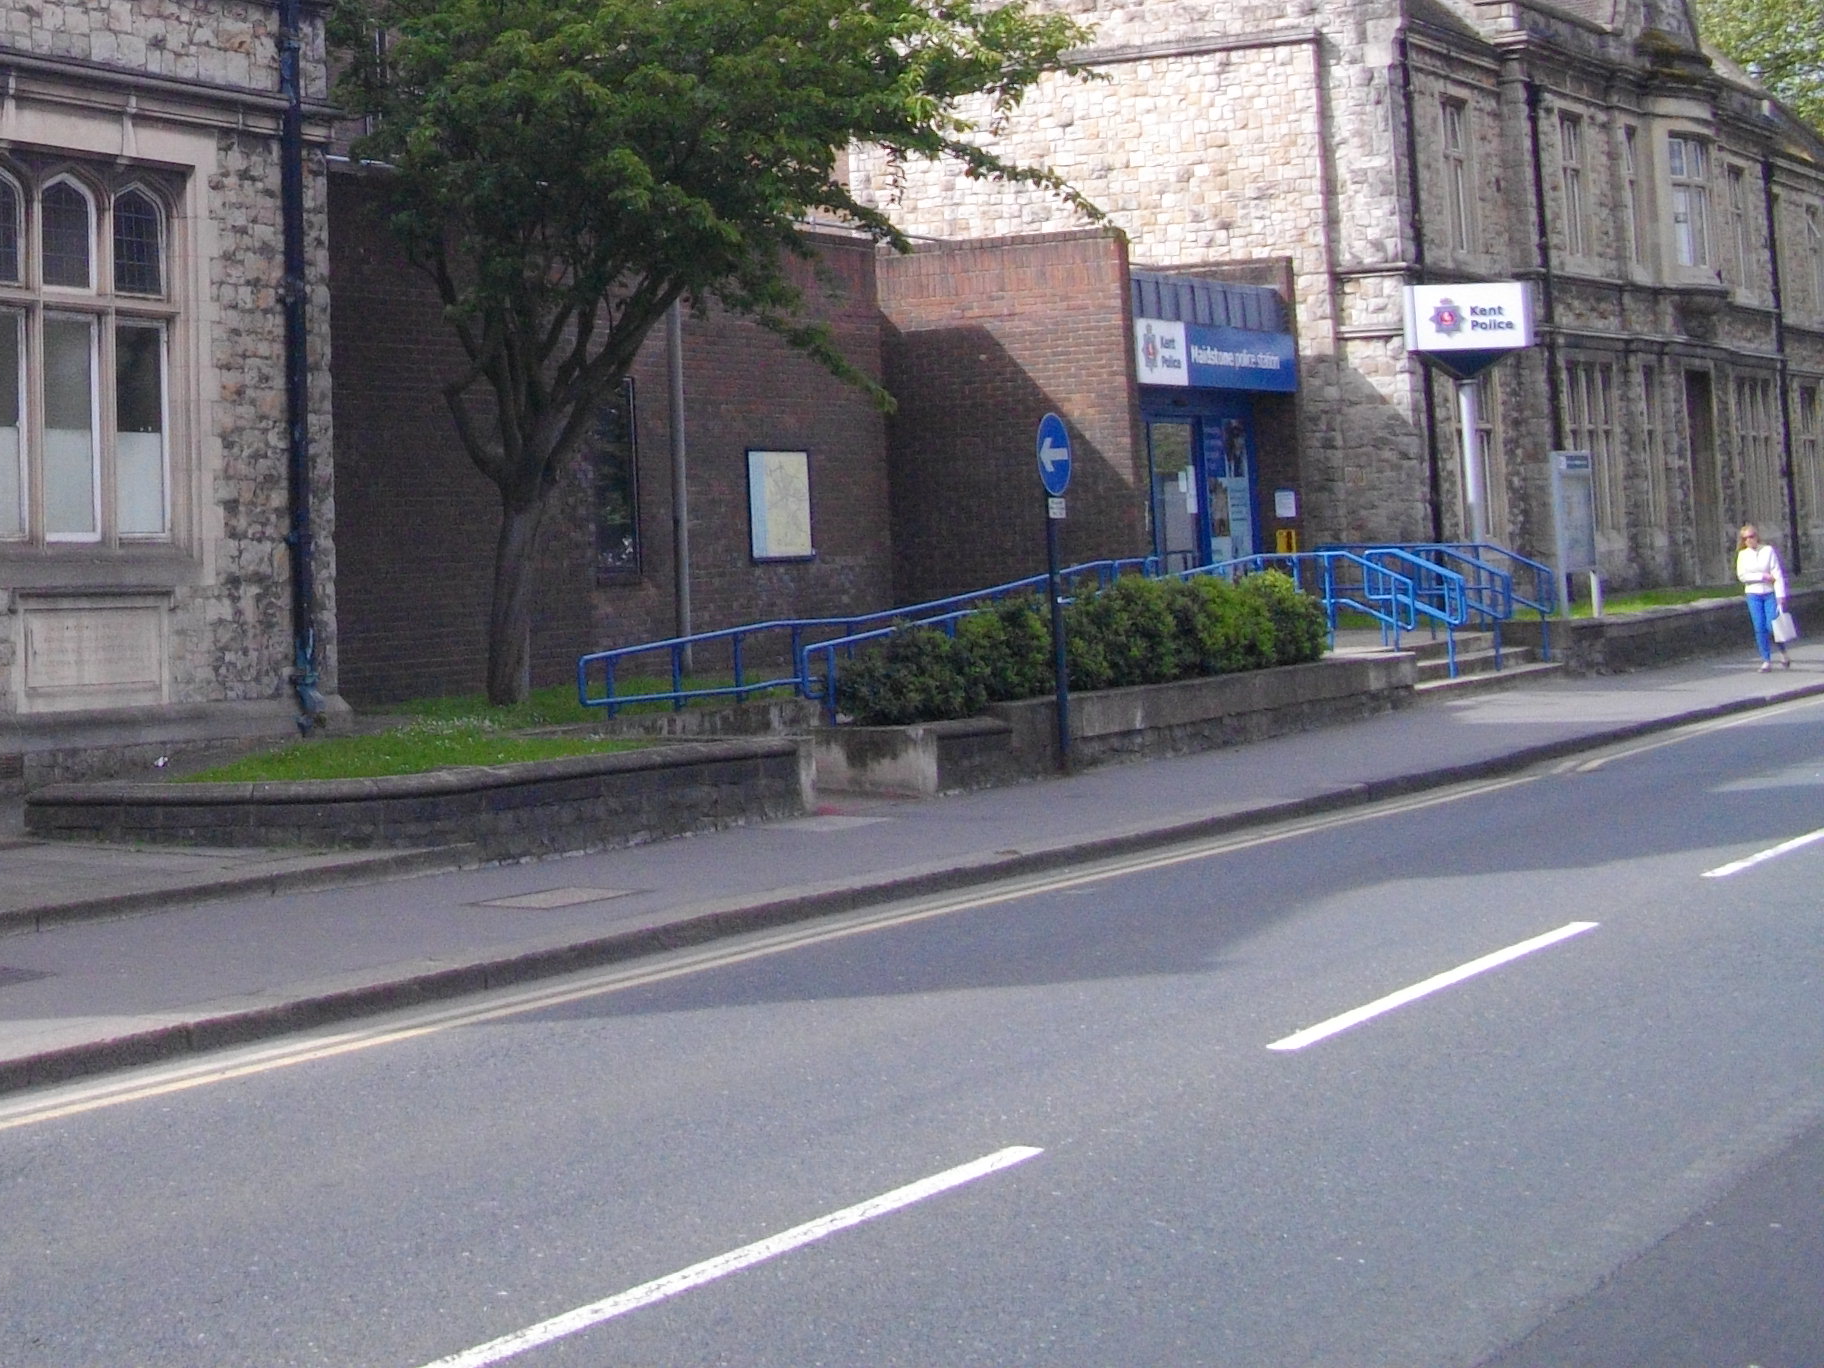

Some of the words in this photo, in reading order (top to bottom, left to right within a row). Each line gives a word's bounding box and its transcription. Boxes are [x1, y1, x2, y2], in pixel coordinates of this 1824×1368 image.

[1470, 306, 1504, 316] Kent
[1471, 319, 1514, 330] Police
[1160, 336, 1175, 349] Kent
[1191, 345, 1234, 365] Maidstone
[1161, 356, 1181, 369] Police
